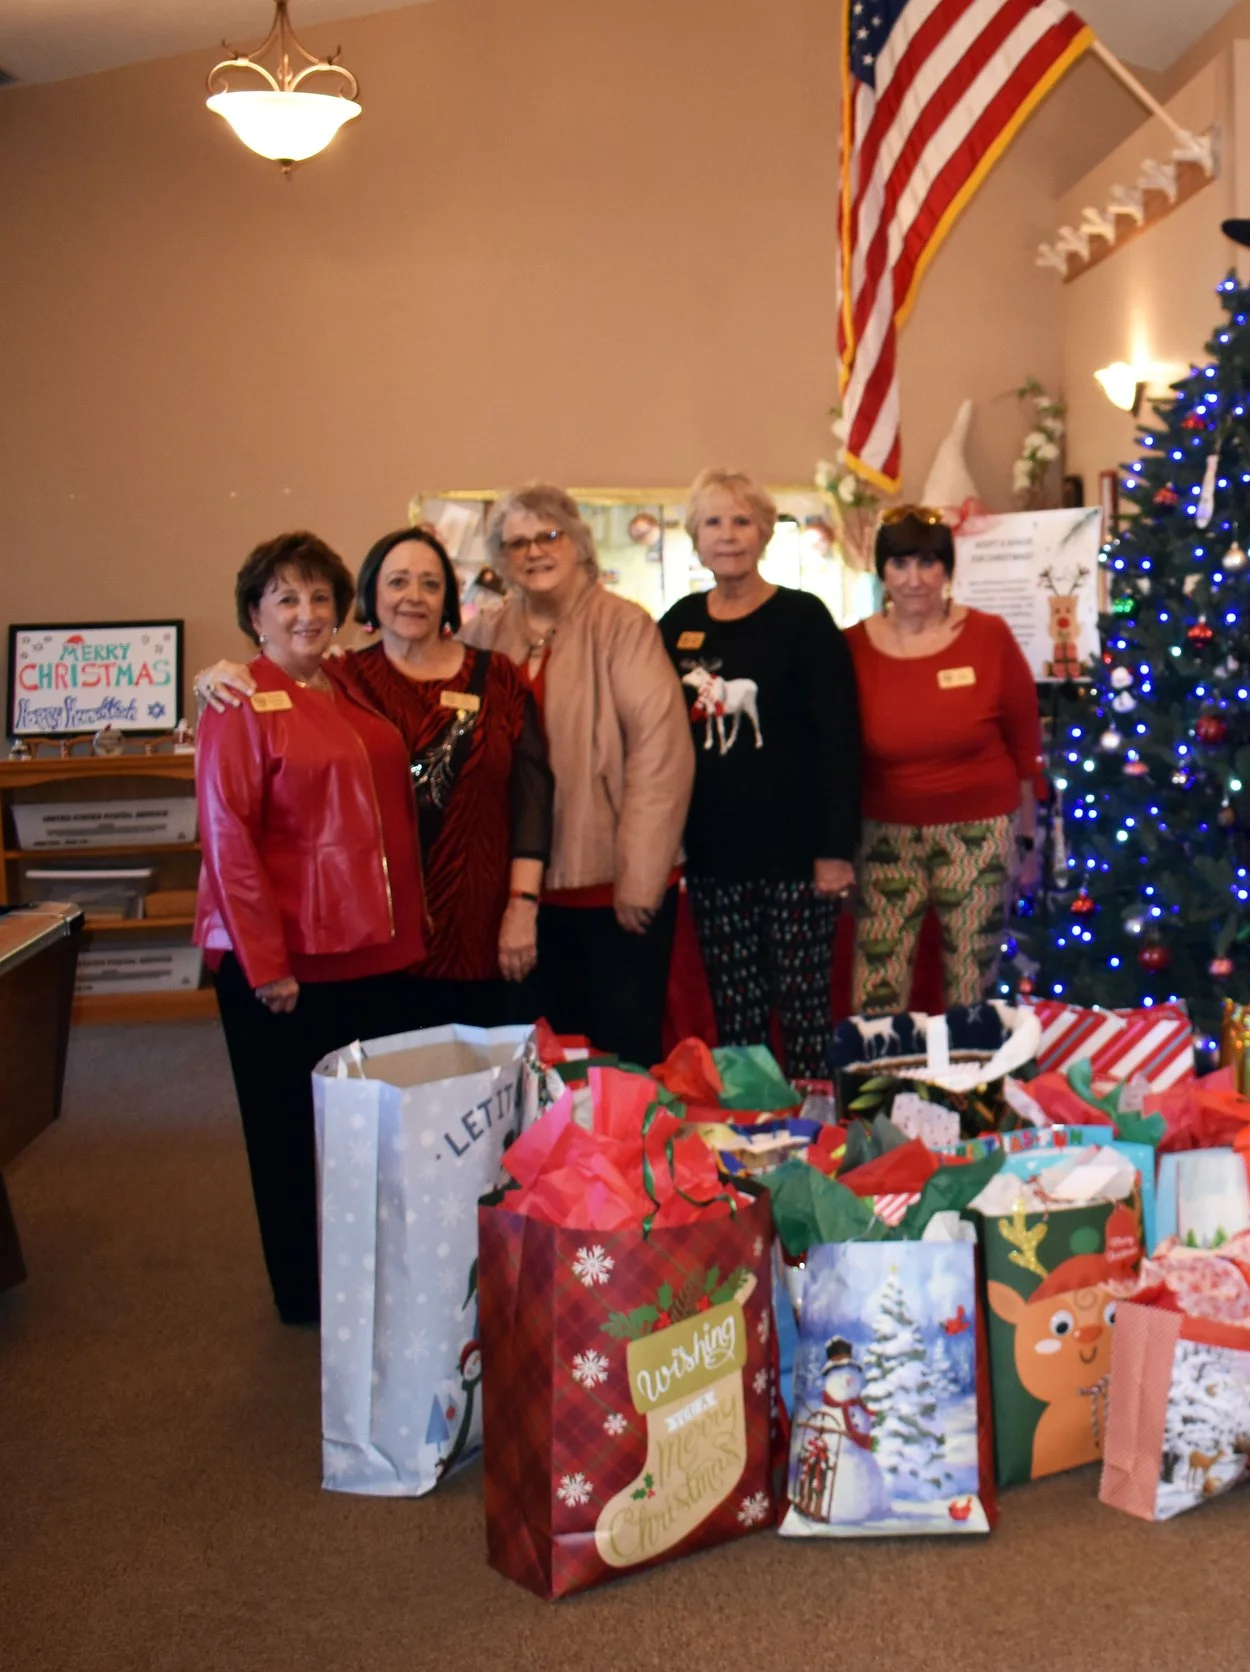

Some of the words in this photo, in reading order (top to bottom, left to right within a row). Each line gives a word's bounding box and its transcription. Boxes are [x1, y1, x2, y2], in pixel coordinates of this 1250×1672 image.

[19, 660, 171, 692] CHRISTMAS
[60, 643, 131, 661] MERRY
[443, 1097, 492, 1157] LET
[496, 1083, 513, 1120] IT
[636, 1315, 737, 1402] Wishing
[656, 1394, 739, 1488] Merry
[608, 1431, 742, 1559] Christmas
